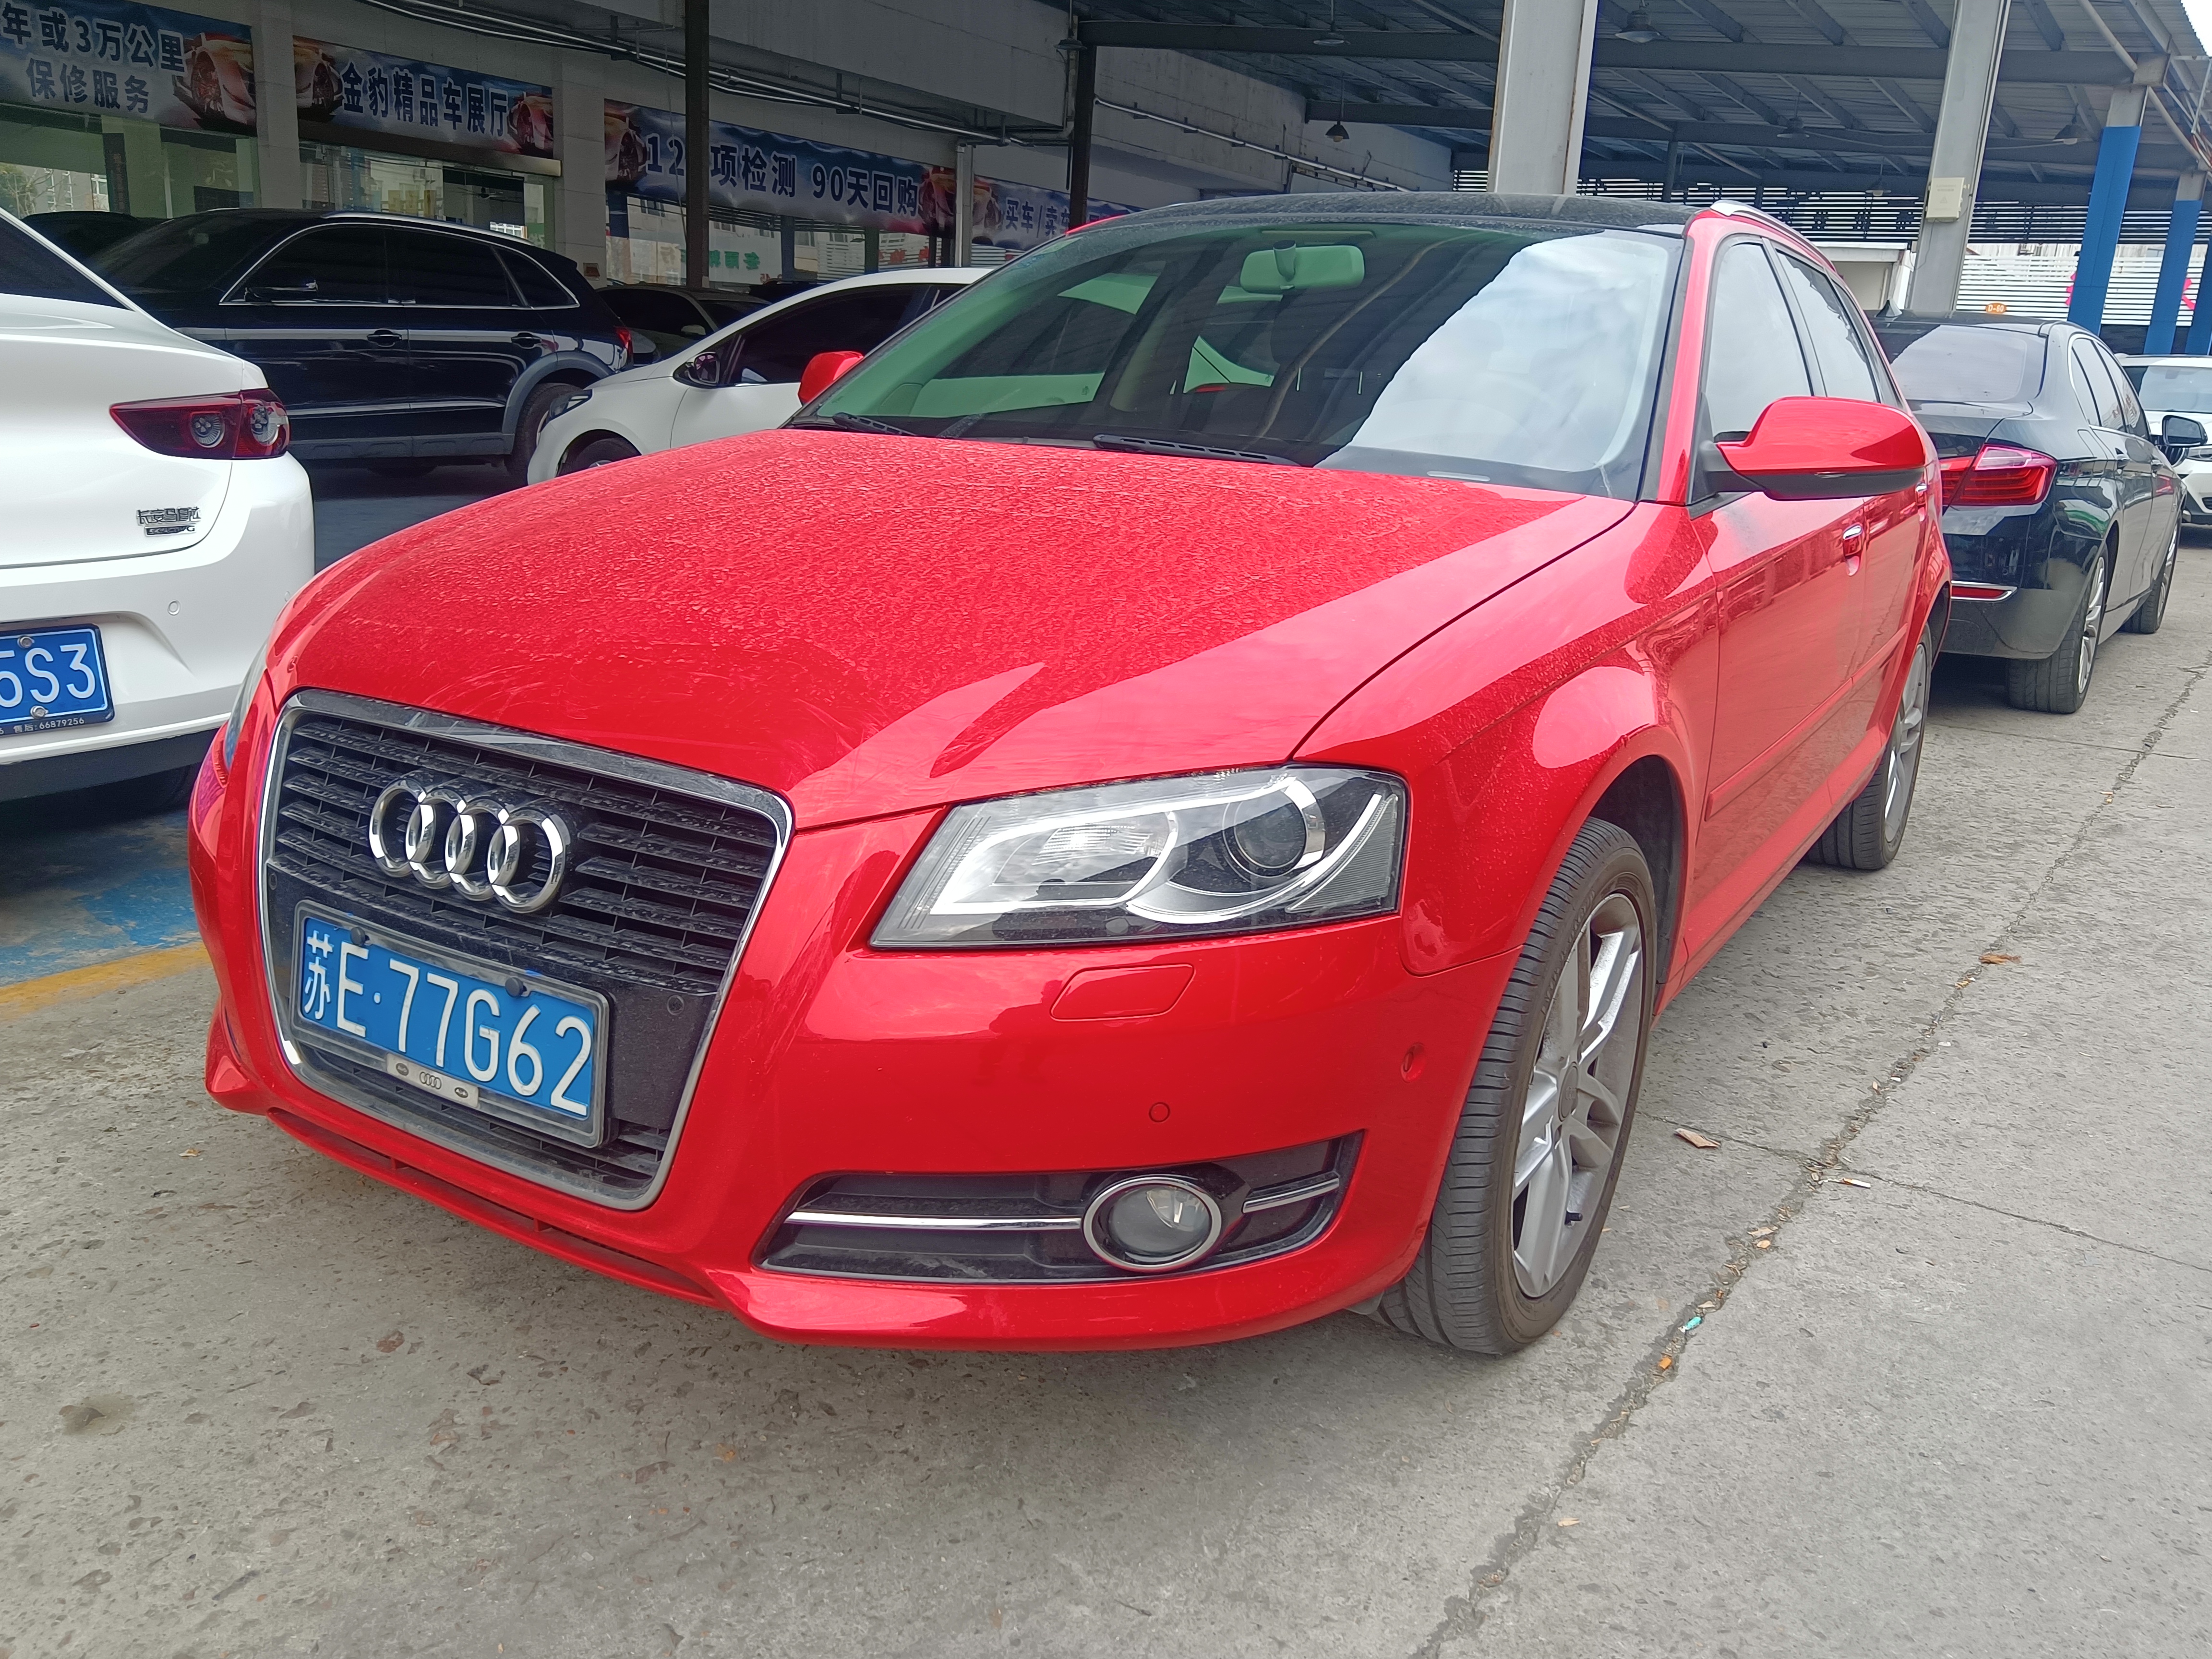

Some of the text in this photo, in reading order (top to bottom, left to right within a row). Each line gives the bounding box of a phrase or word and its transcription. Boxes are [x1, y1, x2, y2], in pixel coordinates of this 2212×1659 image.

[2, 2, 185, 73] 年或3万公里
[25, 57, 150, 114] 保修服务
[341, 61, 508, 137] 金豹精品车展厅
[647, 135, 919, 216] 12项检测 90天回购
[1988, 304, 2004, 313] D-60
[136, 506, 202, 525] 长安马自达
